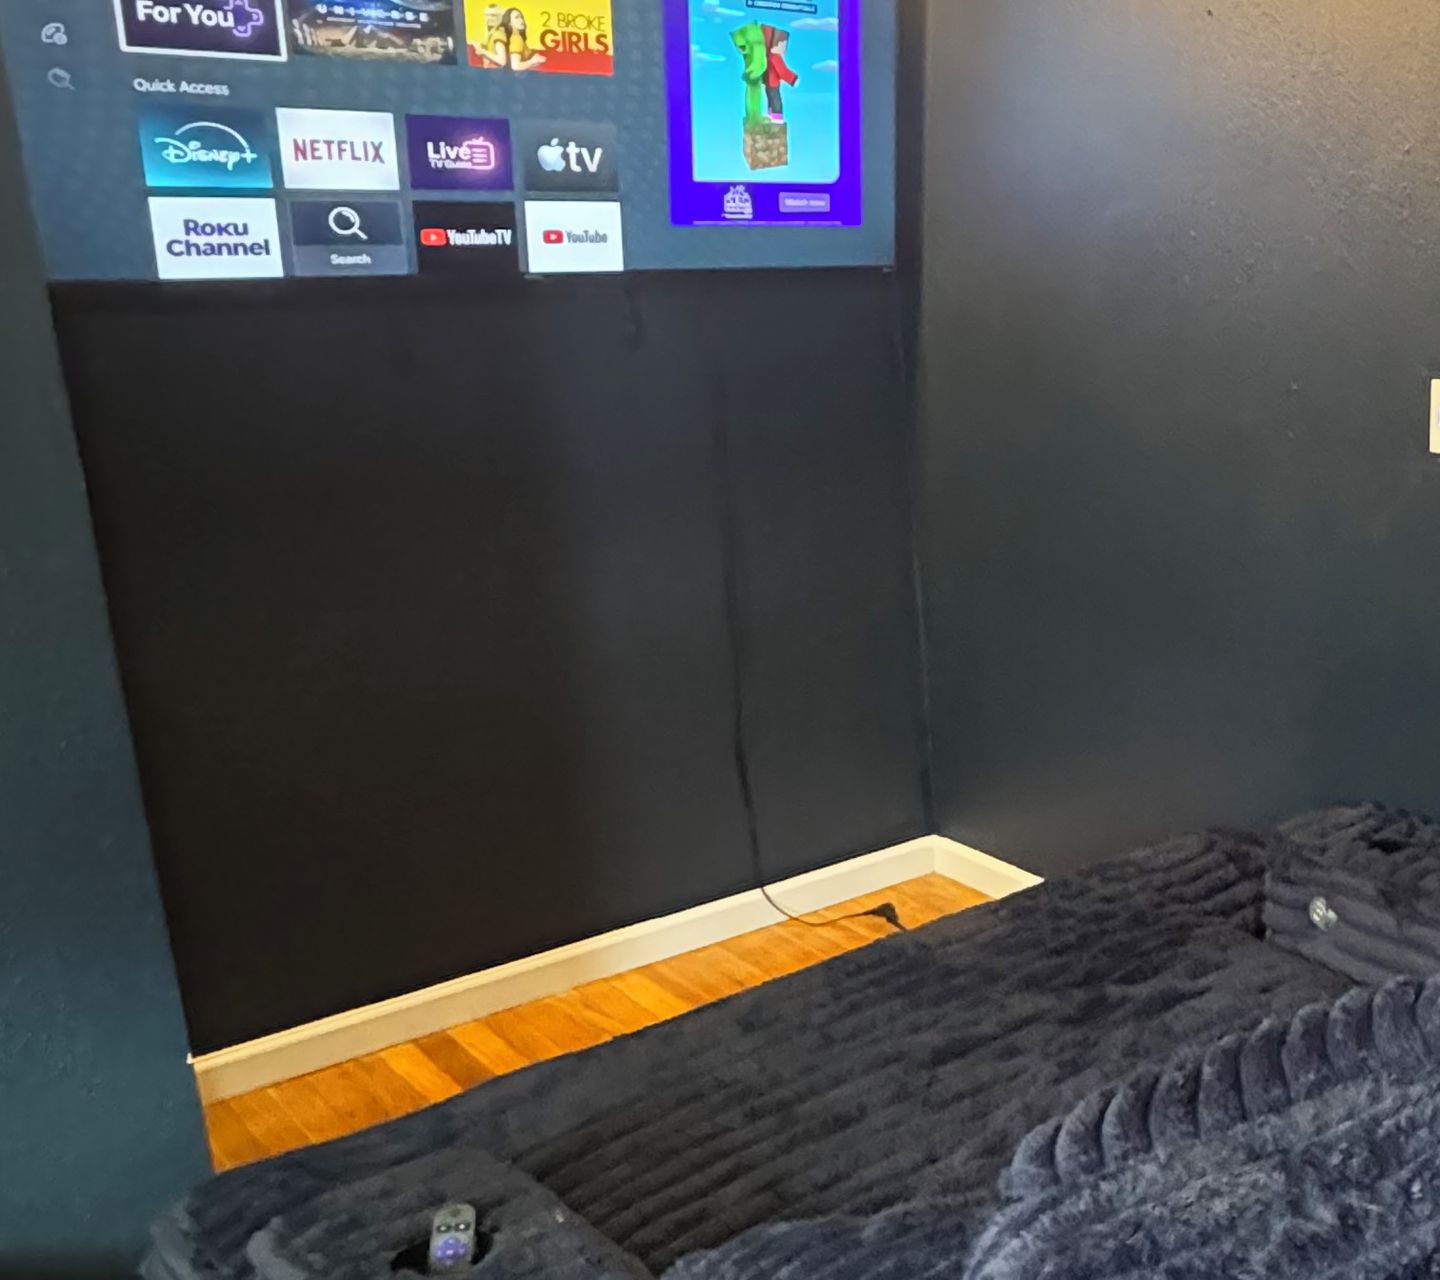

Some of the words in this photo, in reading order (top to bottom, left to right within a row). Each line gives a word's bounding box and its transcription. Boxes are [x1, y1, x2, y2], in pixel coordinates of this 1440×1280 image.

[136, 0, 182, 25] For
[184, 4, 234, 29] You
[540, 11, 551, 28] 2
[557, 12, 606, 32] BROKE
[540, 29, 609, 54] GIRLS
[133, 78, 177, 93] Quick
[179, 80, 230, 96] Access
[292, 137, 386, 164] NETFLIX
[426, 141, 471, 160] Live
[566, 141, 603, 173] tv
[183, 218, 249, 236] Roku
[566, 230, 608, 244] YouTube
[166, 238, 271, 257] Channel
[330, 253, 372, 266] Search
